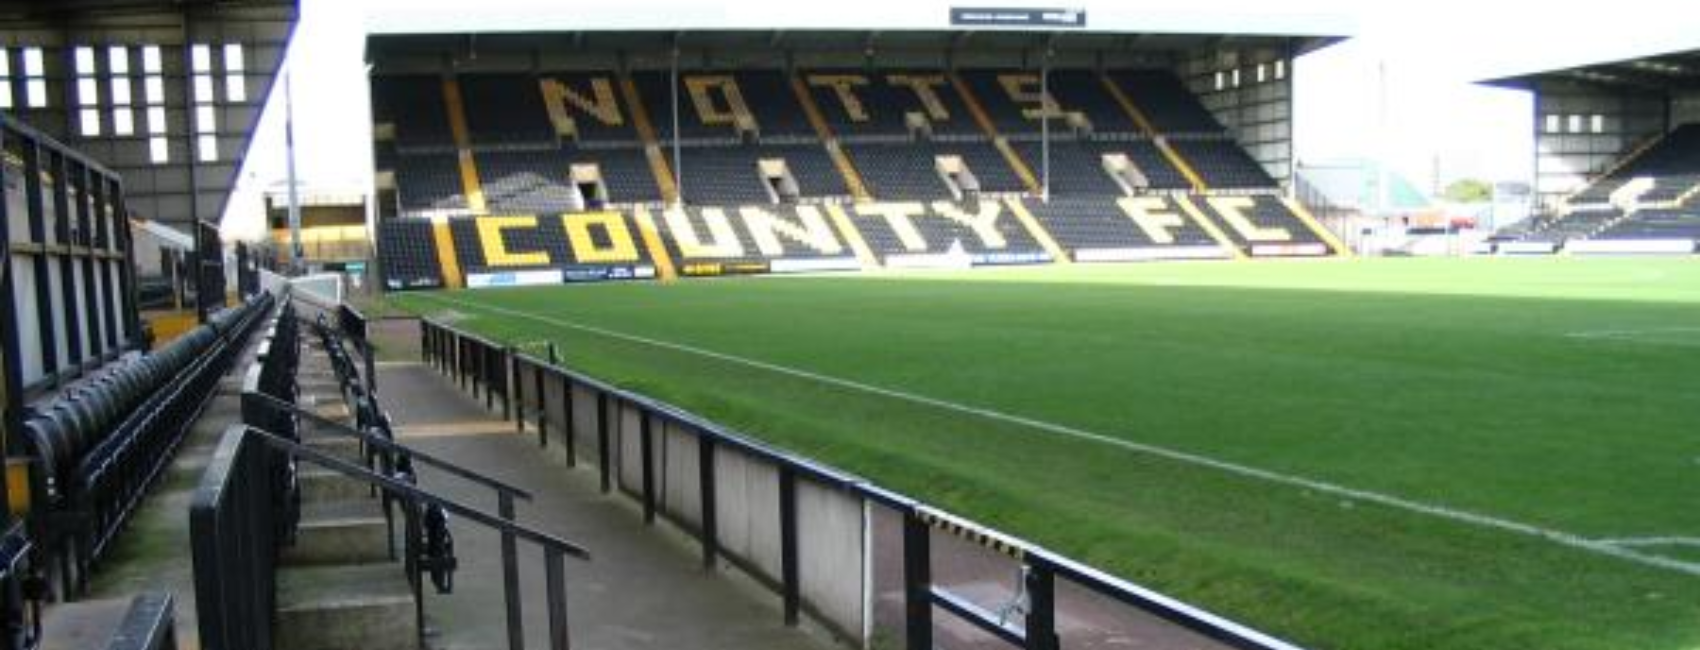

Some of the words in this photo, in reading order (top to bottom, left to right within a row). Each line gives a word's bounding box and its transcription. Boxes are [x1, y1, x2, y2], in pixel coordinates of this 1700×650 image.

[539, 73, 1068, 125] NOTTS
[474, 200, 1008, 266] COUNTY
[1115, 194, 1292, 244] FC
